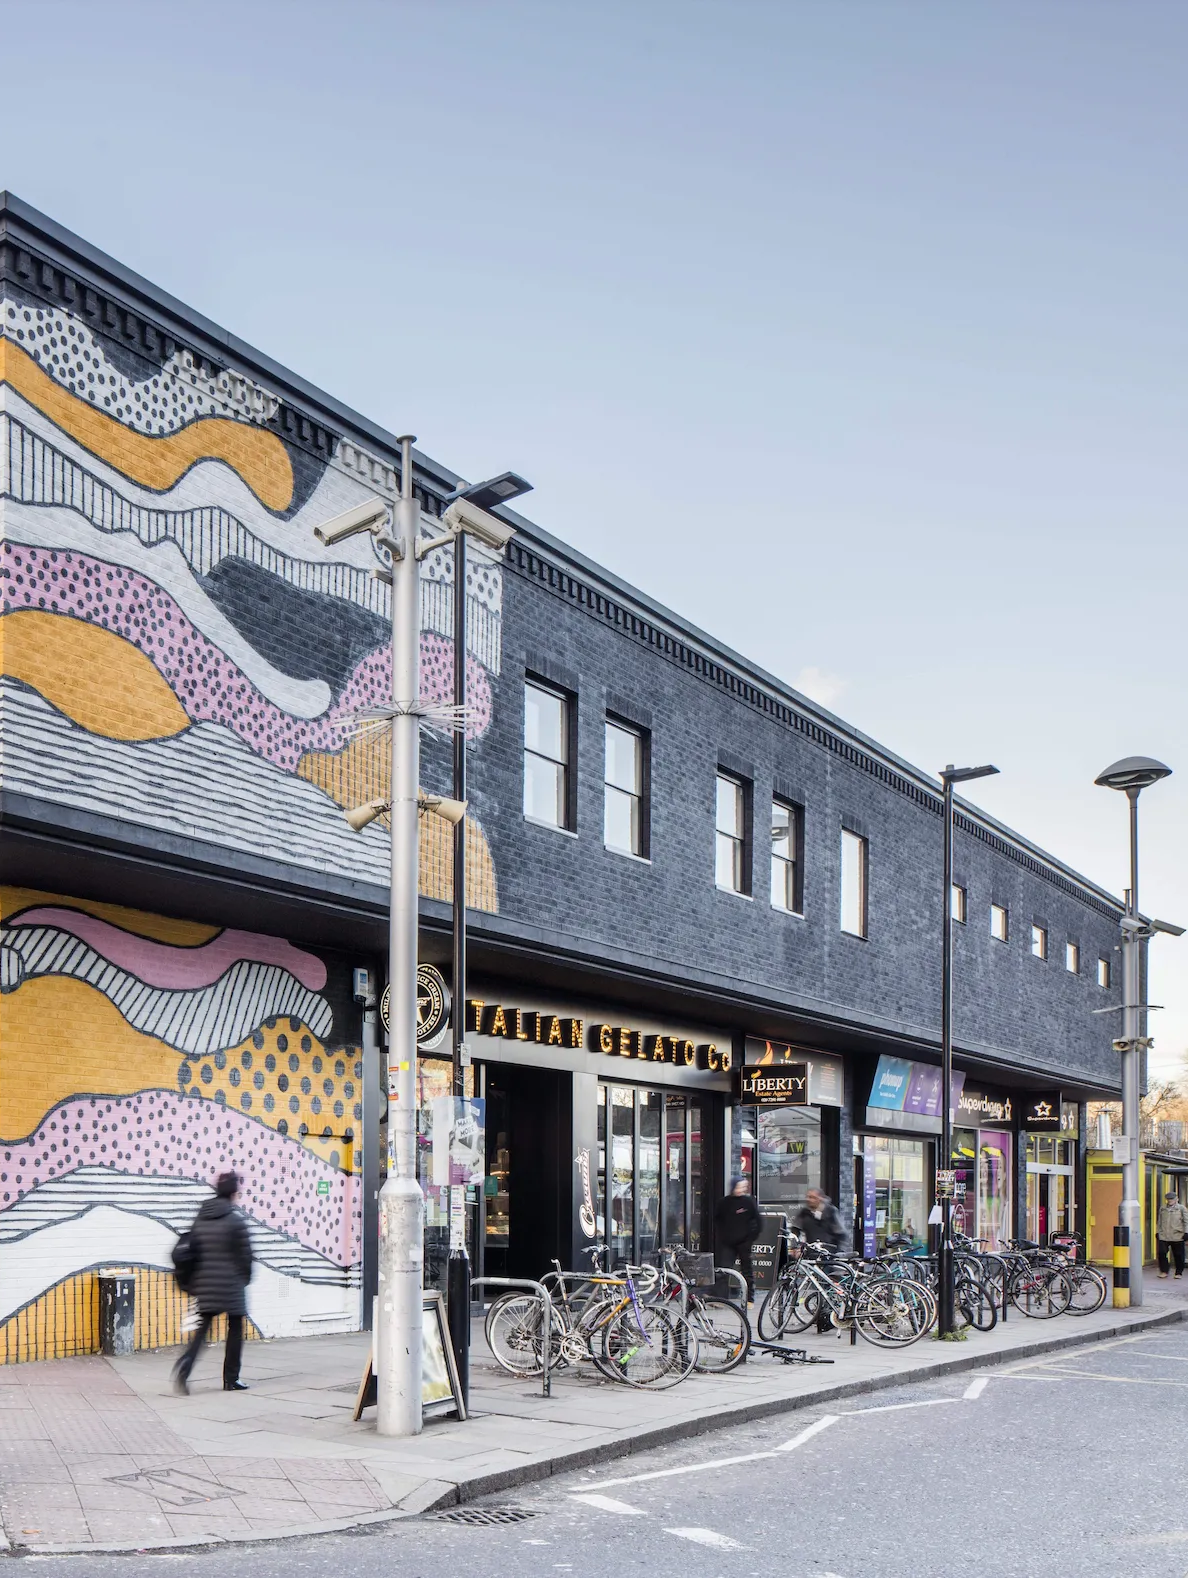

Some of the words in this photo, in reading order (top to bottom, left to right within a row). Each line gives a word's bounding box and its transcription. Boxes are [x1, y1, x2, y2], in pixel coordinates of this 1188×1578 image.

[428, 982, 441, 1010] CREAM
[417, 1014, 437, 1036] OFFEE
[471, 999, 583, 1048] TALIAN
[600, 1023, 694, 1066] GELATO
[743, 1077, 806, 1093] LIBERTY
[958, 1090, 1004, 1119] Superdrug
[751, 1245, 776, 1253] ERTY
